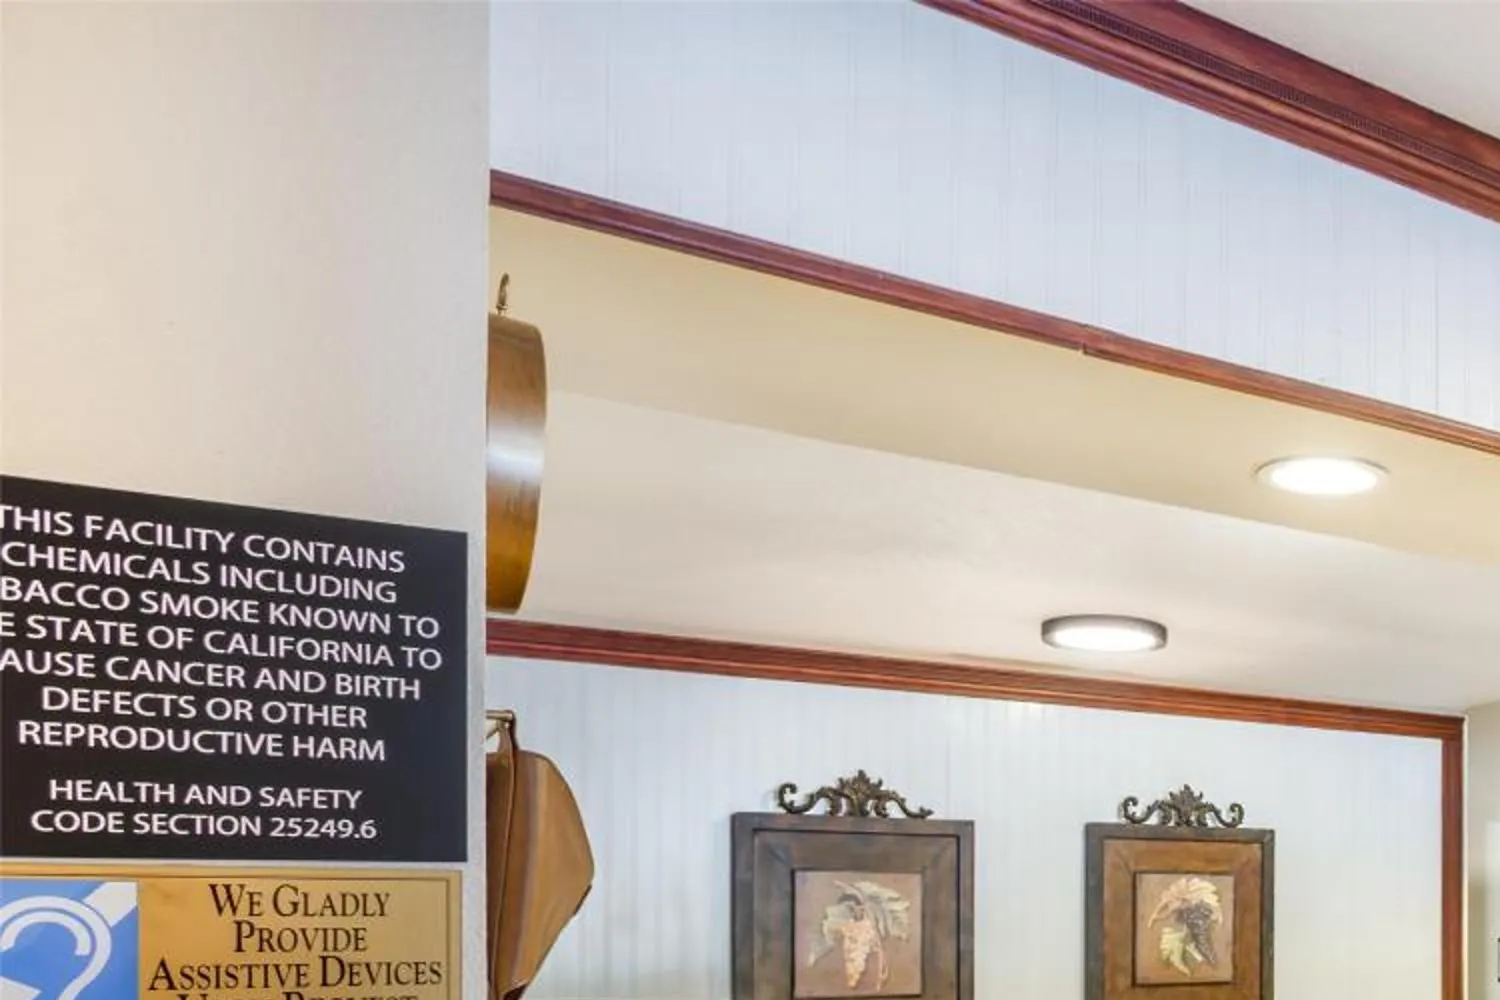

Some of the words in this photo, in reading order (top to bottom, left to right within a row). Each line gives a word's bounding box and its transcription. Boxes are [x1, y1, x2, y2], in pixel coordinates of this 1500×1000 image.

[0, 504, 73, 536] THIS
[85, 515, 234, 553] FACILITY
[243, 535, 405, 572] CONTAINS
[0, 542, 210, 584] CHEMICALS
[221, 565, 396, 603] INCLUDING
[140, 590, 259, 623] SMOKE
[269, 602, 390, 634] KNOWN
[398, 615, 439, 638] TO
[27, 615, 138, 646] STATE
[147, 626, 194, 650] OF
[204, 631, 394, 666] CALIFORNIA
[401, 646, 442, 670] TO
[106, 656, 245, 688] CANCER
[254, 668, 326, 693] AND
[336, 674, 419, 699] BIRTH
[43, 686, 196, 718] DEFECTS
[206, 698, 253, 721] OR
[262, 701, 366, 728] OTHER
[19, 720, 283, 756] REPRODUCTIVE
[293, 736, 384, 760] HARM
[50, 780, 174, 803] HEALTH
[184, 784, 251, 806] AND
[260, 787, 362, 809] SAFETY
[31, 810, 124, 833] CODE
[133, 813, 260, 836] SECTION
[270, 818, 376, 838] 25249.6
